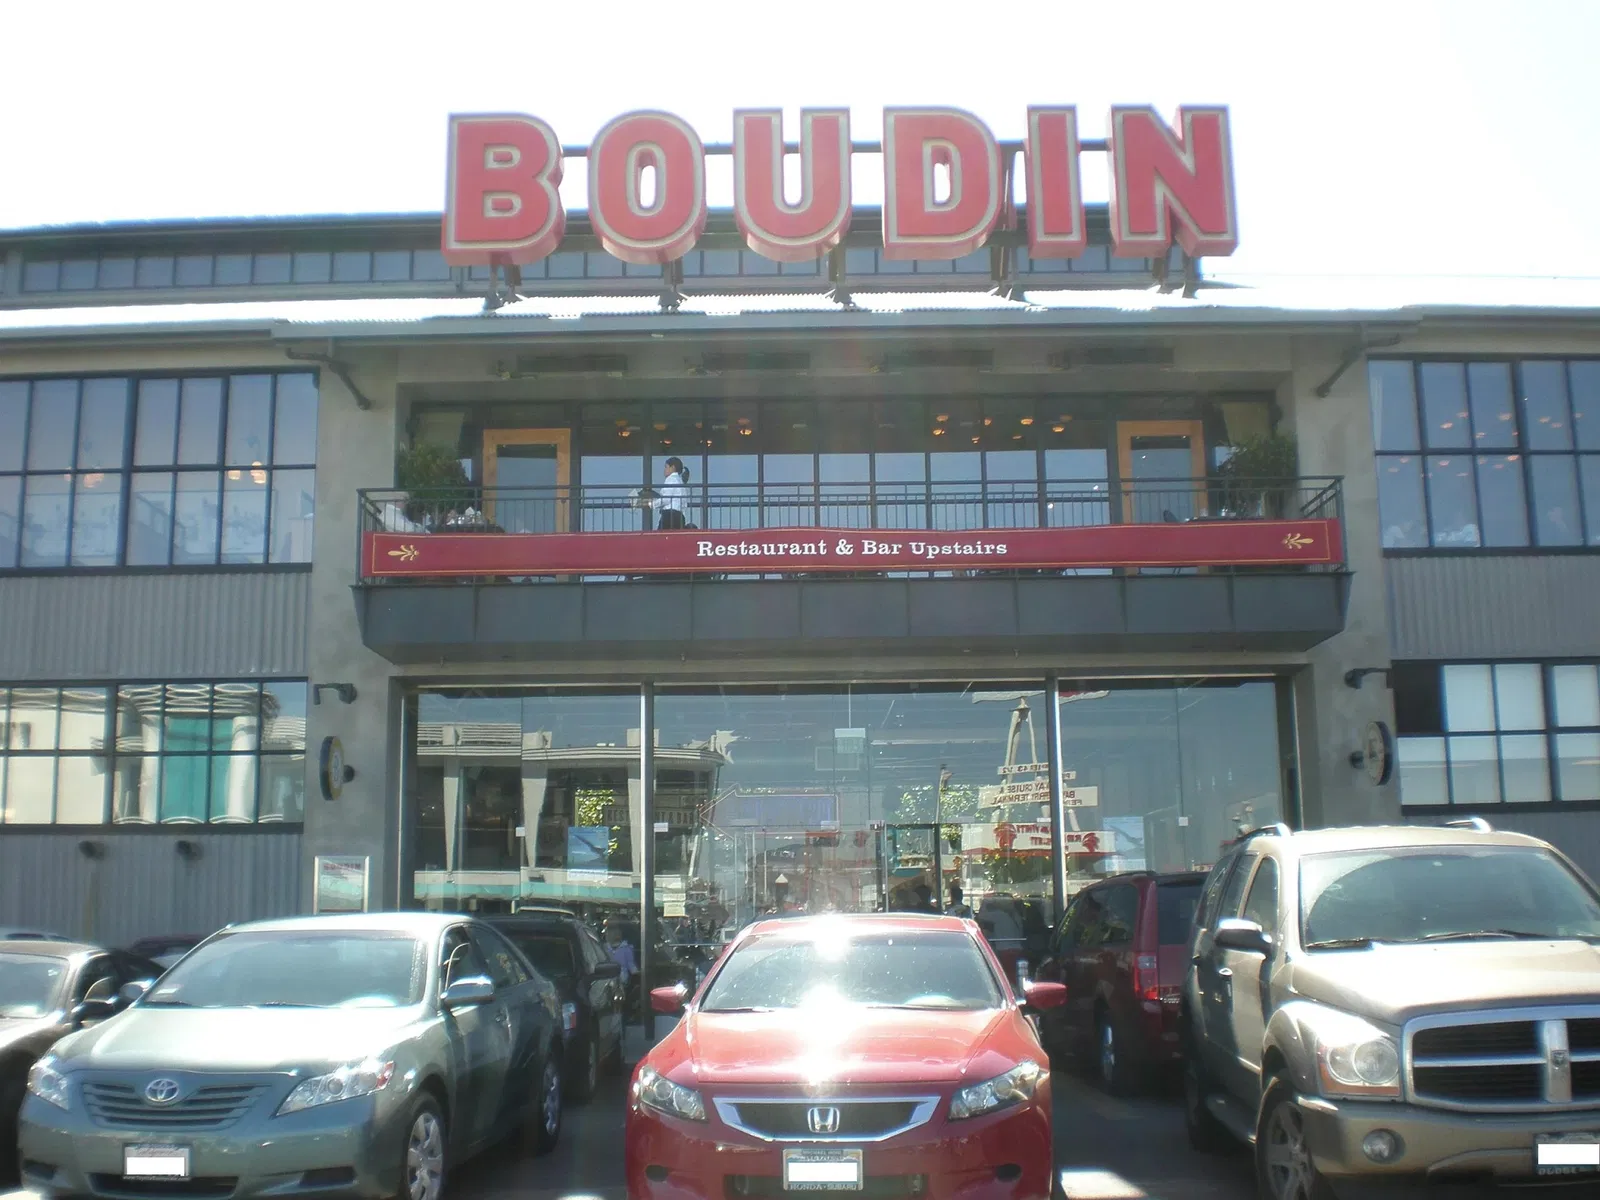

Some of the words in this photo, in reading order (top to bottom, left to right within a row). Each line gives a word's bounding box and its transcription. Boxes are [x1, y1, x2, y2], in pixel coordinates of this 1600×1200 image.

[442, 103, 1238, 266] BOUDIN
[696, 538, 827, 557] Restaurant
[835, 539, 854, 555] &
[861, 539, 903, 555] Bar
[909, 540, 1008, 559] Upstairs
